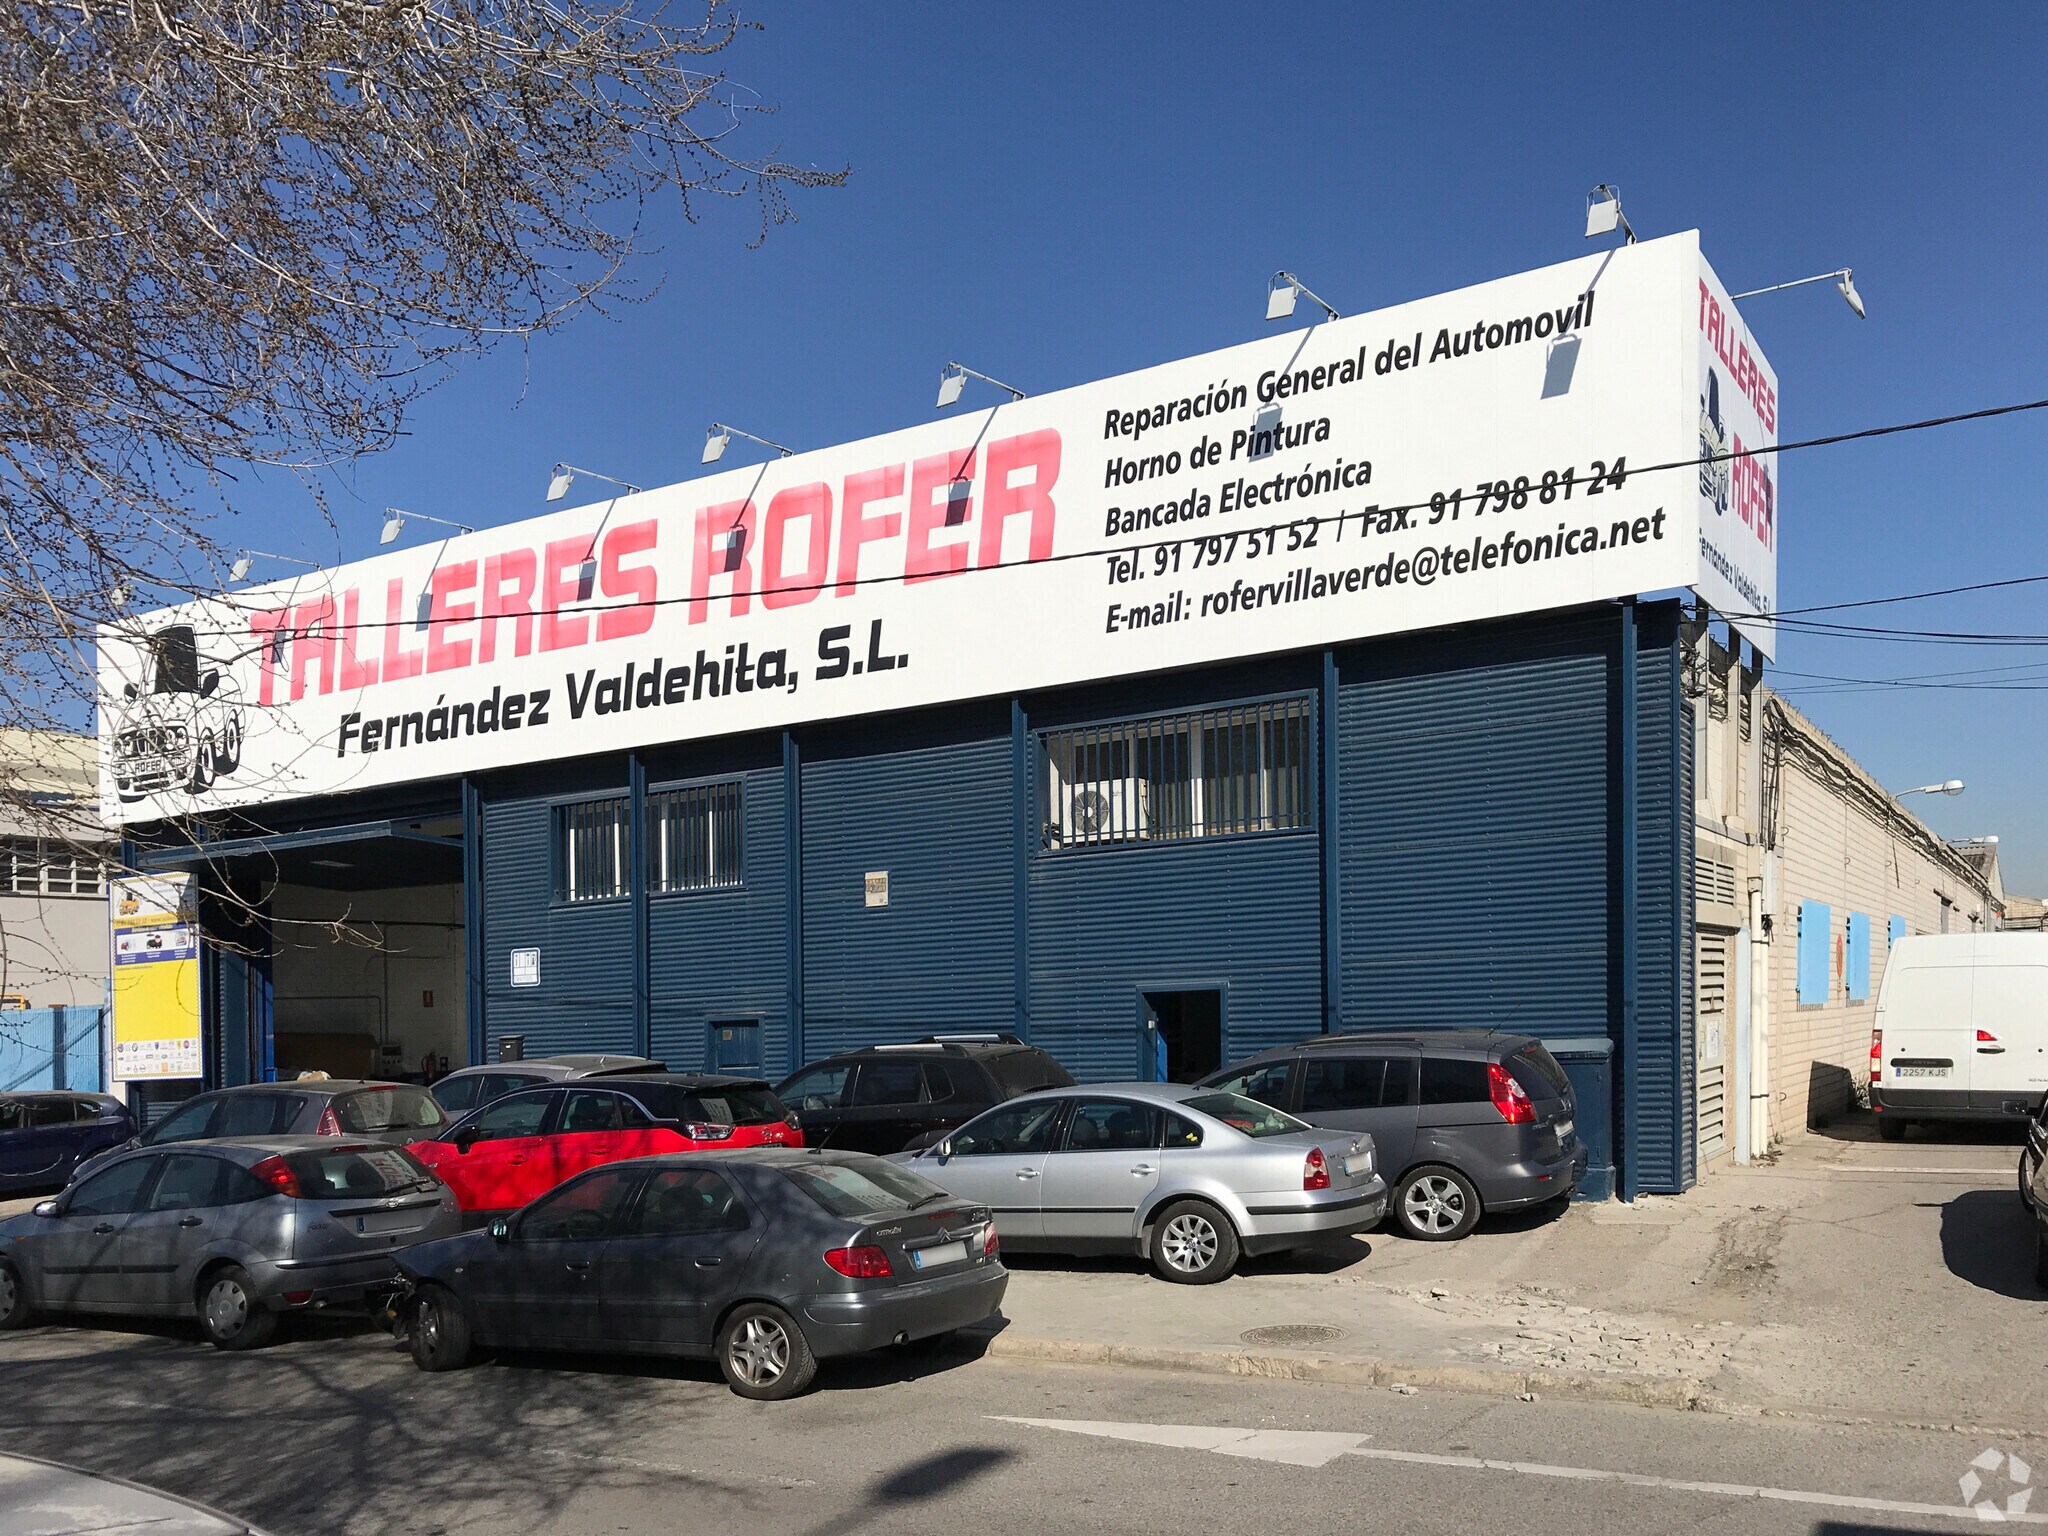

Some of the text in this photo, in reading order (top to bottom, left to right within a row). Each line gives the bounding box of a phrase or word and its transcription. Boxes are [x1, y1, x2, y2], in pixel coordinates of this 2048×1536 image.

[1104, 290, 1595, 440] Reparación General del Automovil
[1698, 275, 1776, 436] TALLERES
[1104, 417, 1331, 488] Horno de Pintura
[1105, 457, 1372, 537] Bancada Electrónica
[1731, 431, 1774, 554] ROFER
[250, 427, 1062, 707] TALLERES ROFER
[1106, 506, 1666, 633] E-mail: rofervillaverde@telefonica.net
[1107, 546, 1145, 585] Tel.
[1153, 541, 1182, 576] 91
[1192, 532, 1239, 569] 797
[1246, 525, 1277, 559] 51
[1287, 516, 1319, 552] 52
[1361, 504, 1417, 538] Fax.
[1428, 488, 1462, 525] 91
[1474, 475, 1529, 516] 798
[1539, 467, 1575, 504] 81
[1587, 456, 1626, 496] 24
[1699, 527, 1733, 585] ernández
[338, 618, 909, 758] Fernández Valdehita, S.L.
[1902, 1068, 1947, 1077] 2257 KJS
